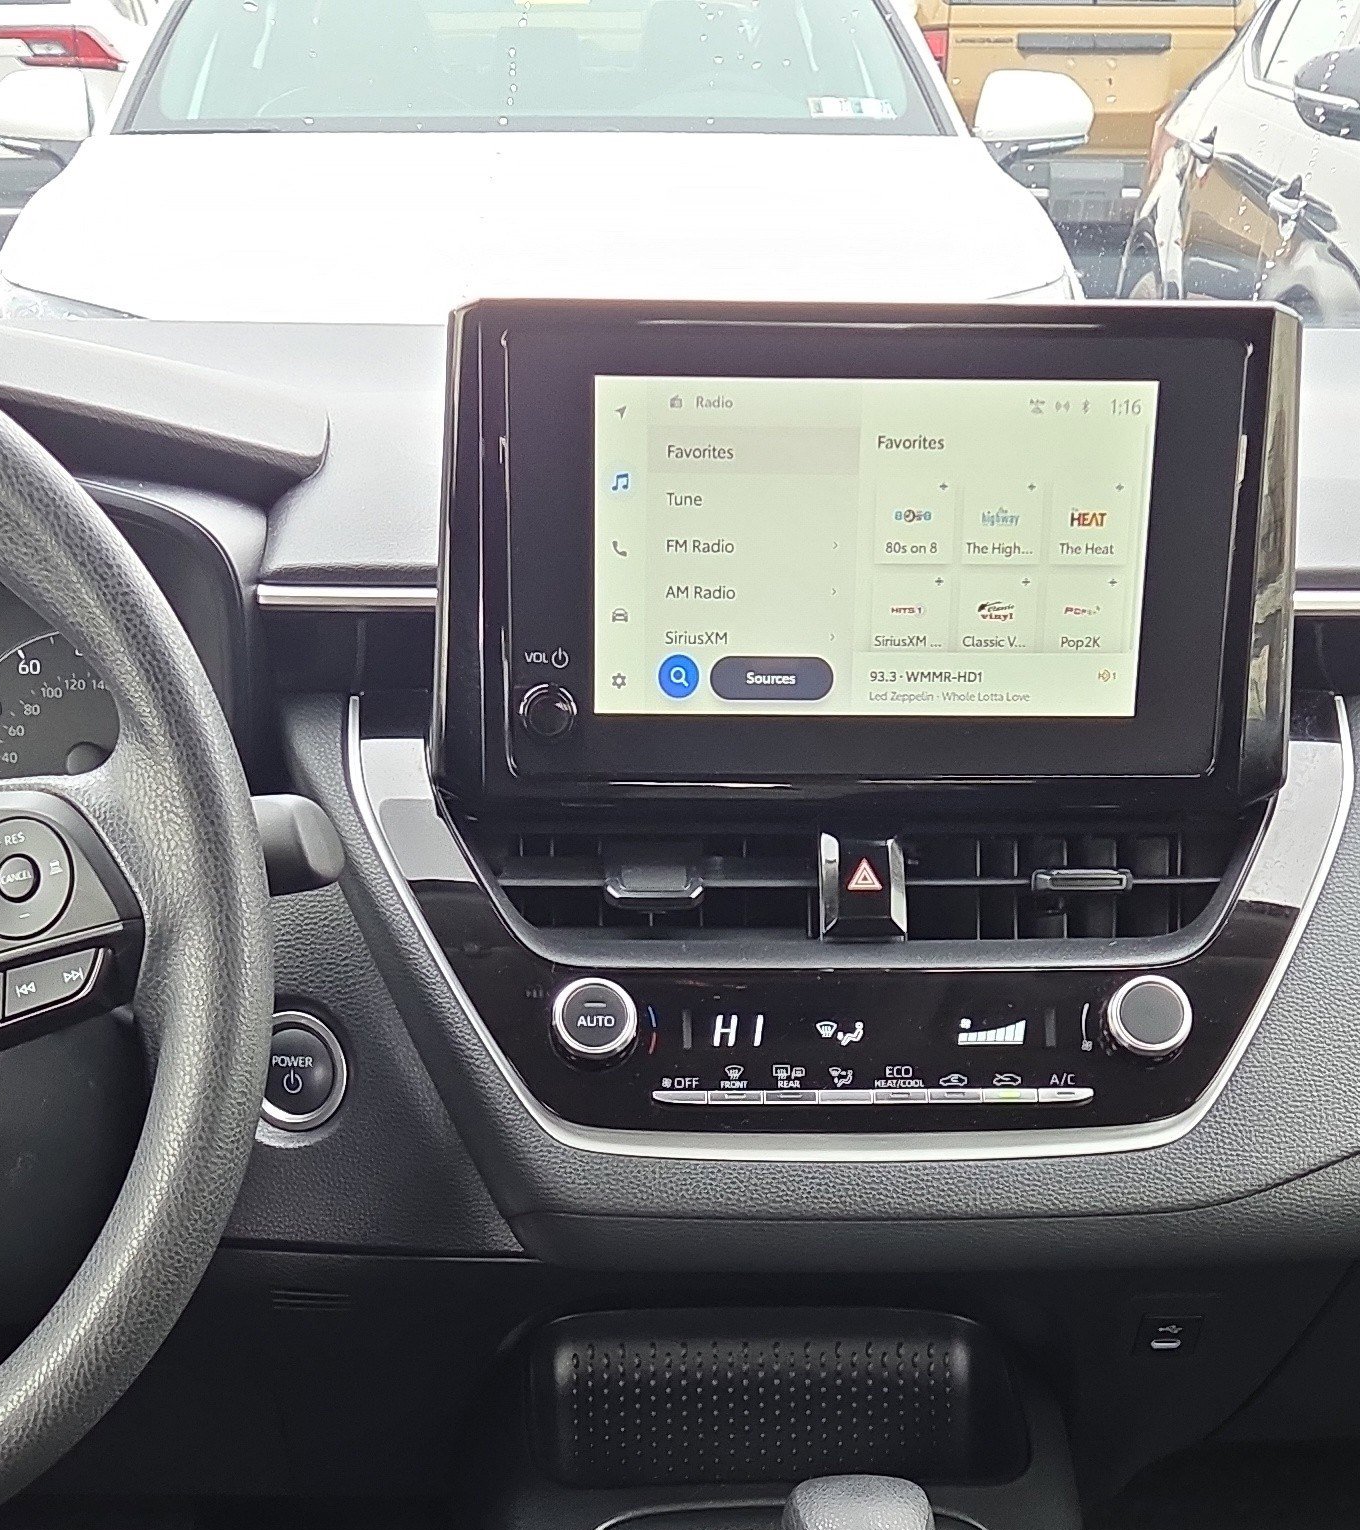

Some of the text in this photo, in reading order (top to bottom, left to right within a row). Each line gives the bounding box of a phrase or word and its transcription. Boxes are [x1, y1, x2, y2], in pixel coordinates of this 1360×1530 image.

[695, 395, 733, 409] Radio
[1110, 398, 1142, 415] 1:16
[877, 435, 945, 450] Favorites
[667, 444, 734, 459] Favorites
[667, 492, 703, 507] Tune
[666, 539, 735, 554] FM Radio
[885, 541, 937, 554] 80s on 8
[967, 542, 989, 555] The
[1060, 542, 1115, 555] The Heat
[665, 585, 736, 600] AM Radio
[664, 631, 728, 645] SiriusXM
[874, 636, 927, 648] SiriusXM
[962, 636, 1005, 648] Classic
[1060, 636, 1101, 650] Pop2K
[525, 651, 548, 664] VOL
[18, 660, 41, 675] 60
[746, 671, 796, 685] Sources
[869, 671, 983, 683] 93.3 WMMR-HD1
[64, 679, 86, 691] 120
[91, 679, 107, 690] 14
[41, 686, 63, 699] 100
[869, 691, 1030, 704] Led Zeppelin Whole Lotta Love
[23, 704, 41, 716] 80
[8, 725, 25, 737] 60
[1, 752, 18, 764] 40
[4, 831, 26, 846] RES
[0, 871, 33, 885] CANCEL
[576, 1015, 615, 1027] AUTO
[712, 1014, 764, 1047] HI
[272, 1055, 314, 1068] POWER
[885, 1066, 913, 1078] ECO
[674, 1078, 700, 1089] OFF
[720, 1080, 748, 1089] FRONT
[778, 1080, 801, 1089] REAR
[874, 1079, 925, 1088] HEAT/COOL
[1049, 1073, 1076, 1086] A/C
